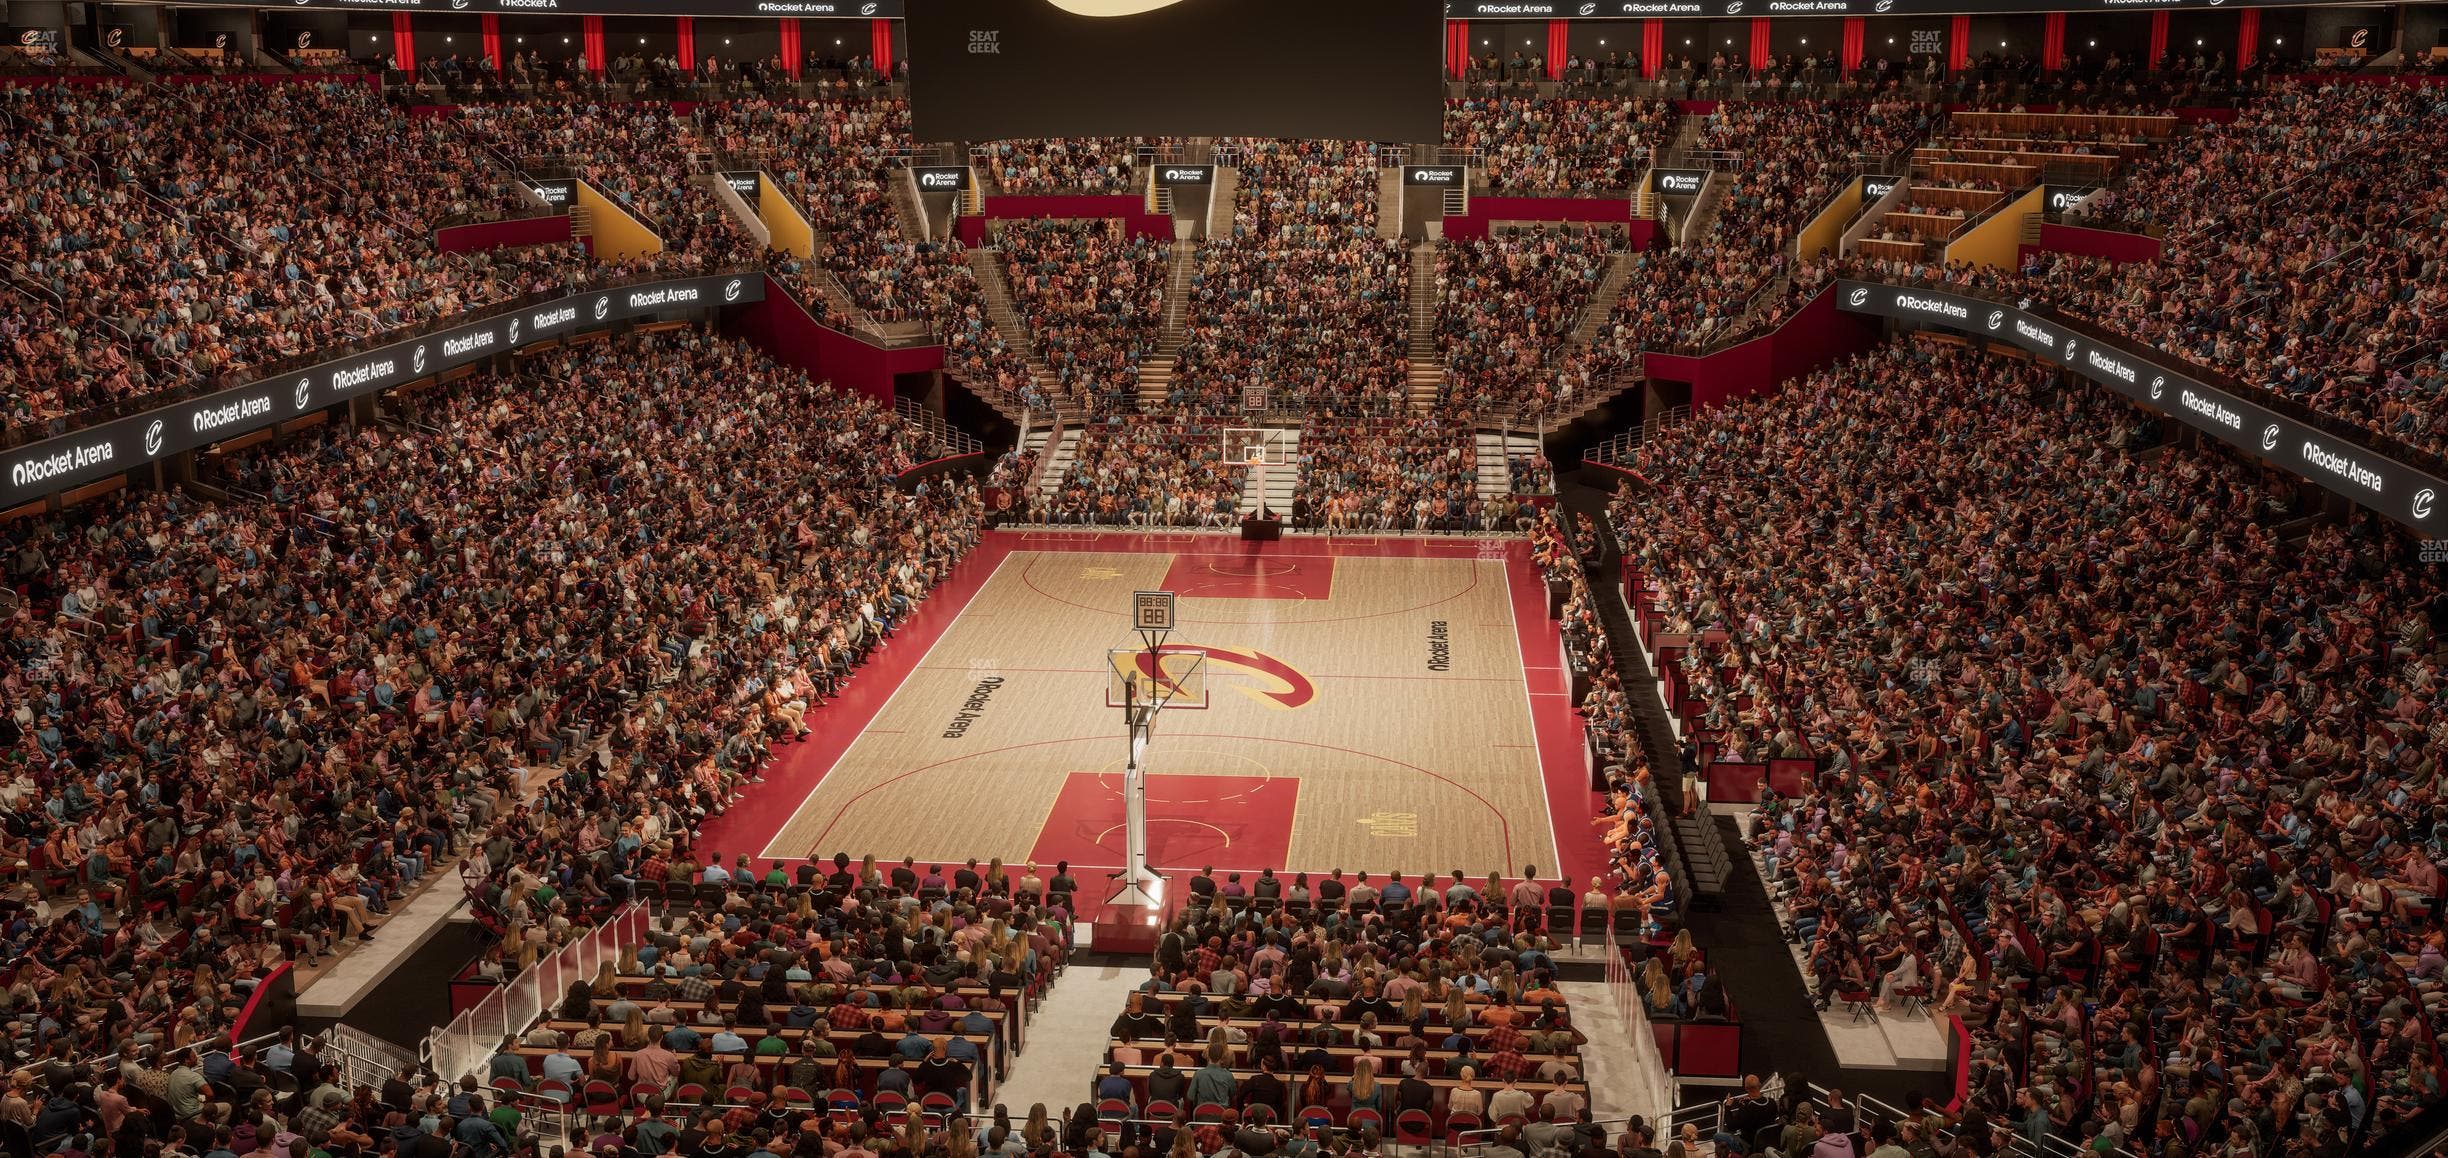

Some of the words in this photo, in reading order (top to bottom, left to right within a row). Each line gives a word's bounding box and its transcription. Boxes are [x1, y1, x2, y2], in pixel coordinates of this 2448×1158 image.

[511, 0, 547, 8] Rocket
[768, 3, 803, 12] Rocket
[804, 3, 834, 12] Arena
[1487, 4, 1522, 13] Rocket
[1522, 4, 1552, 13] Arena
[1632, 4, 1668, 12] Rocket
[1669, 3, 1700, 12] Arena
[1780, 2, 1814, 10] Rocket
[1816, 2, 1847, 10] Arena
[1676, 182, 1696, 190] Arena
[637, 289, 665, 307] Rocket
[666, 287, 698, 302] Arena
[1906, 296, 1943, 313] Rocket
[1943, 302, 1968, 318] Arena
[539, 310, 559, 329] Rocket
[558, 306, 576, 323] Arena
[449, 334, 474, 356] Rocket
[474, 330, 494, 348] Arena
[2022, 320, 2038, 340] Rocket
[2038, 327, 2054, 347] Arena
[340, 363, 370, 389] Rocket
[370, 360, 394, 379] Arena
[2095, 352, 2116, 375] Rocket
[2116, 361, 2136, 383] Arena
[203, 402, 240, 430] Rocket
[241, 396, 271, 420] Arena
[2189, 392, 2215, 418] Rocket
[2216, 404, 2241, 430] Arena
[27, 450, 74, 484] Rocket
[75, 442, 114, 469] Arena
[2312, 444, 2348, 477] Rocket
[2348, 461, 2382, 492] Arena
[1140, 597, 1168, 607] 88:88
[1144, 609, 1164, 624] 88
[1426, 620, 1448, 640] Arena
[1427, 641, 1449, 664] Rocket
[960, 684, 1002, 712] Rocket
[942, 712, 982, 738] Arena
